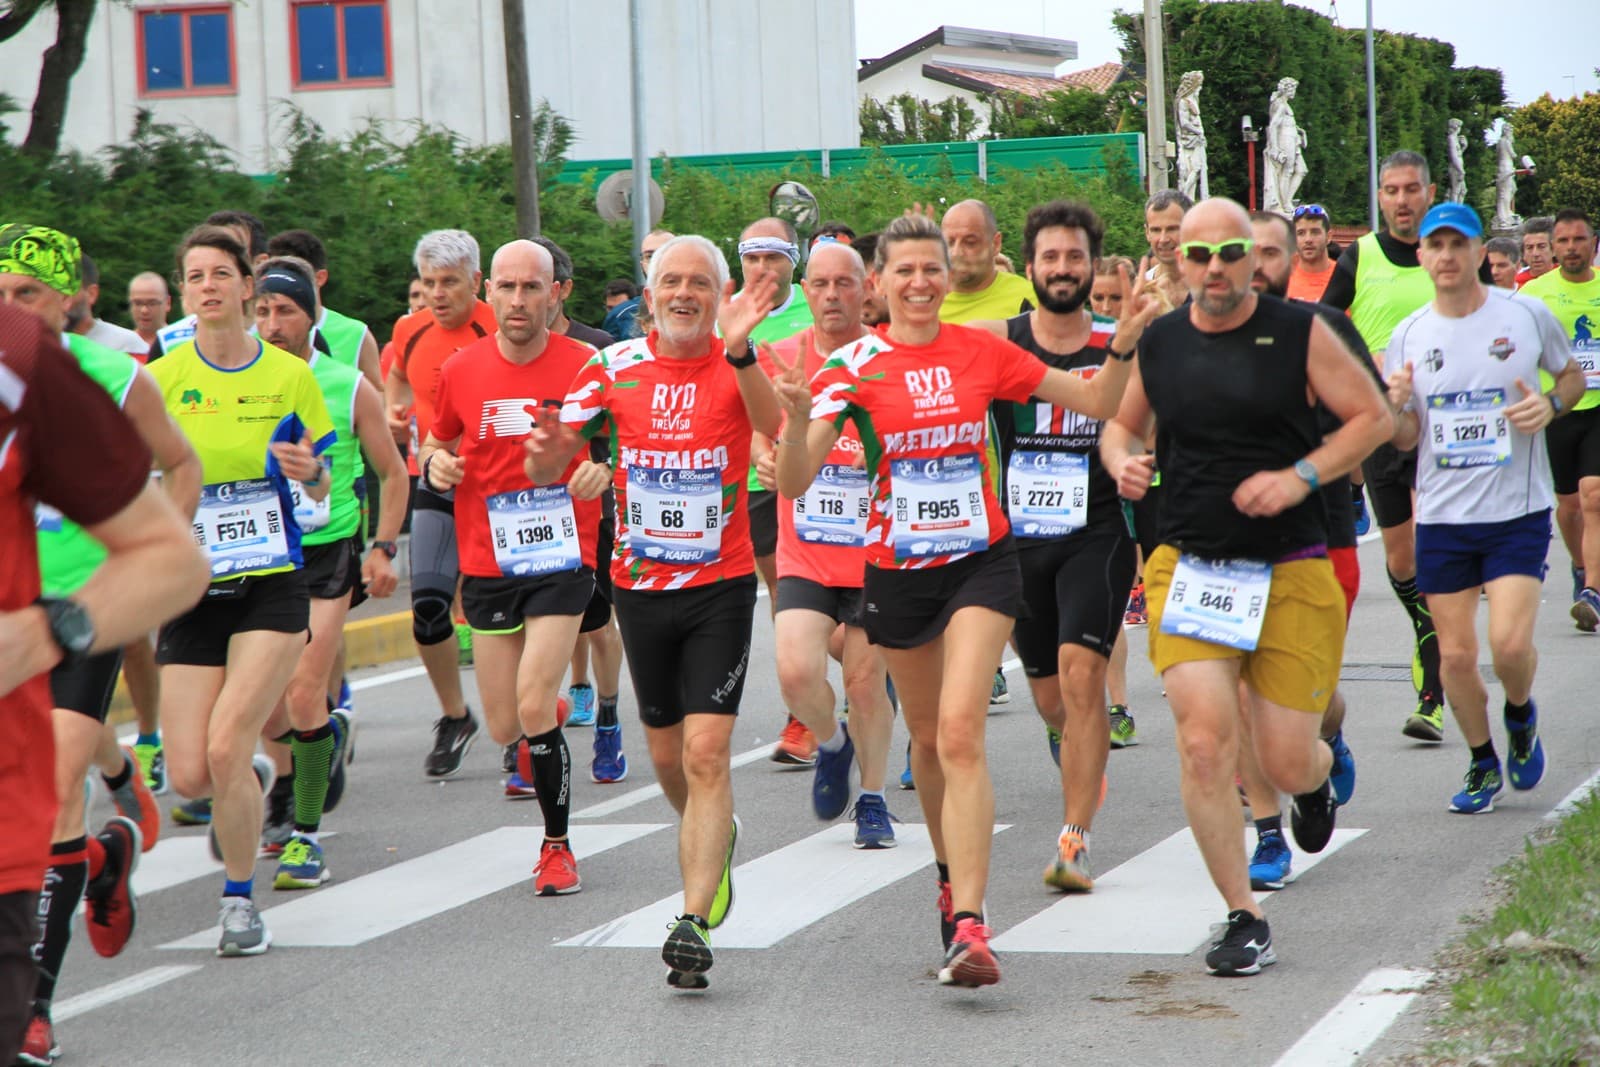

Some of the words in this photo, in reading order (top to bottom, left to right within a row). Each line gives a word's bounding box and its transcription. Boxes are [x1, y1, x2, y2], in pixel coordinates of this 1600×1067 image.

[1577, 360, 1594, 370] 23
[904, 366, 953, 393] RYD
[651, 382, 697, 410] RYD
[913, 390, 955, 409] TREVISO
[651, 409, 690, 431] TREVISO
[883, 421, 983, 454] METALCO
[1453, 424, 1487, 441] 1297
[620, 445, 729, 471] METALCO
[819, 499, 843, 515] 118
[1027, 490, 1064, 506] 2727
[661, 510, 684, 528] 68
[918, 499, 960, 520] F955
[216, 519, 257, 541] F574
[516, 525, 554, 545] 1398
[1039, 525, 1072, 535] KARHU
[665, 550, 704, 560] KARHU
[934, 539, 972, 552] KARHU
[235, 555, 273, 569] KARHU
[532, 558, 566, 572] KARHU
[1199, 591, 1234, 612] 846
[557, 744, 569, 806] BOOSTER
